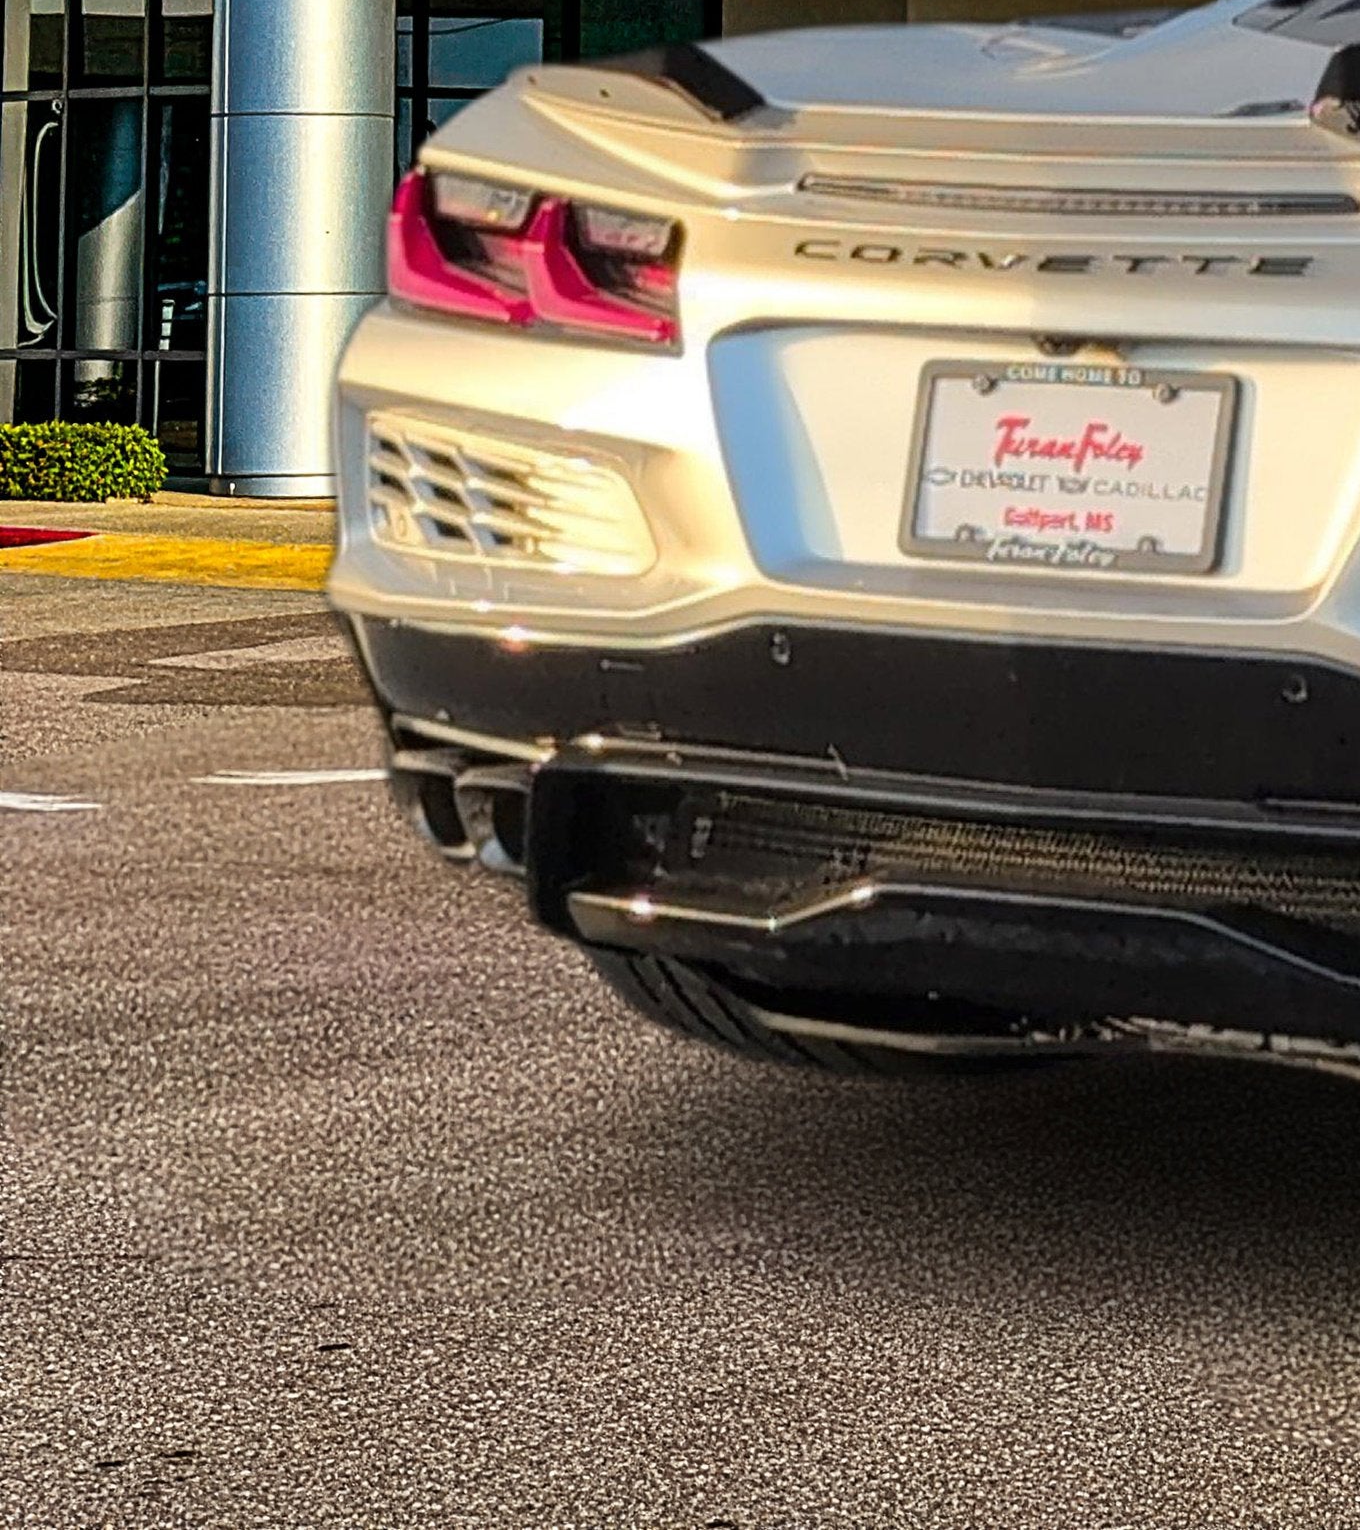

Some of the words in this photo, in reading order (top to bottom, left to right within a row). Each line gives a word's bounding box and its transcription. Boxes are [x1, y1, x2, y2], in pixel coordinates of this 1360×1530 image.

[794, 239, 1316, 276] CORVETTE
[995, 418, 1076, 468] Turan
[1073, 423, 1144, 473] Foley
[1093, 476, 1208, 502] CADILLAC
